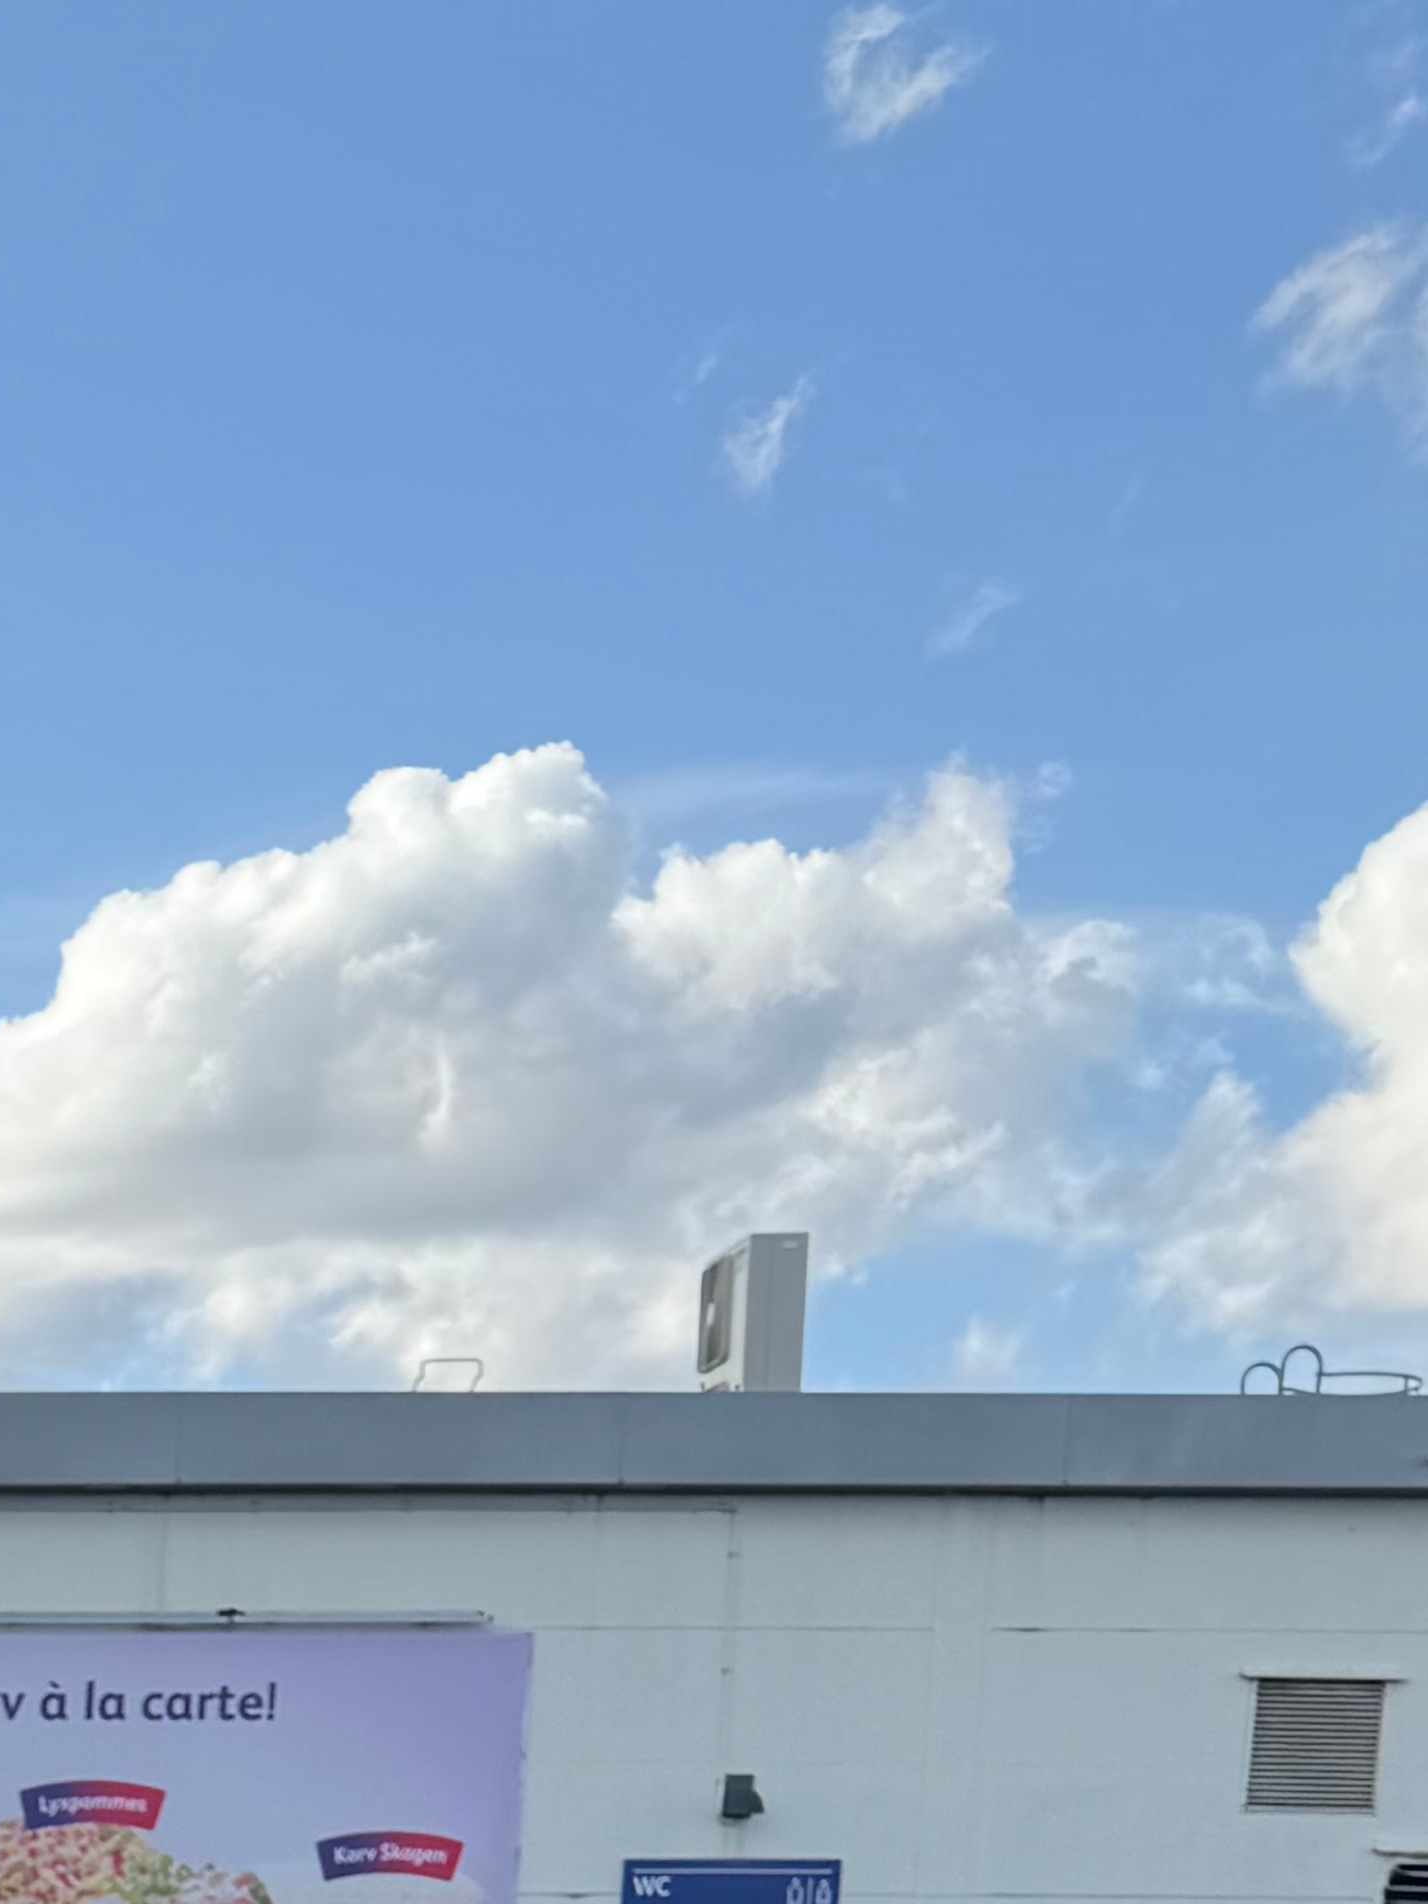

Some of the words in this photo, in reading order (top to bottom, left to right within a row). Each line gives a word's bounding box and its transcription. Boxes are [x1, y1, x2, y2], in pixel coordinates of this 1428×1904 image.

[39, 1680, 68, 1721] à
[84, 1680, 126, 1721] la
[140, 1681, 278, 1721] carte!
[334, 1846, 378, 1865] Korv
[379, 1842, 448, 1867] Skagen
[633, 1875, 672, 1898] WC
